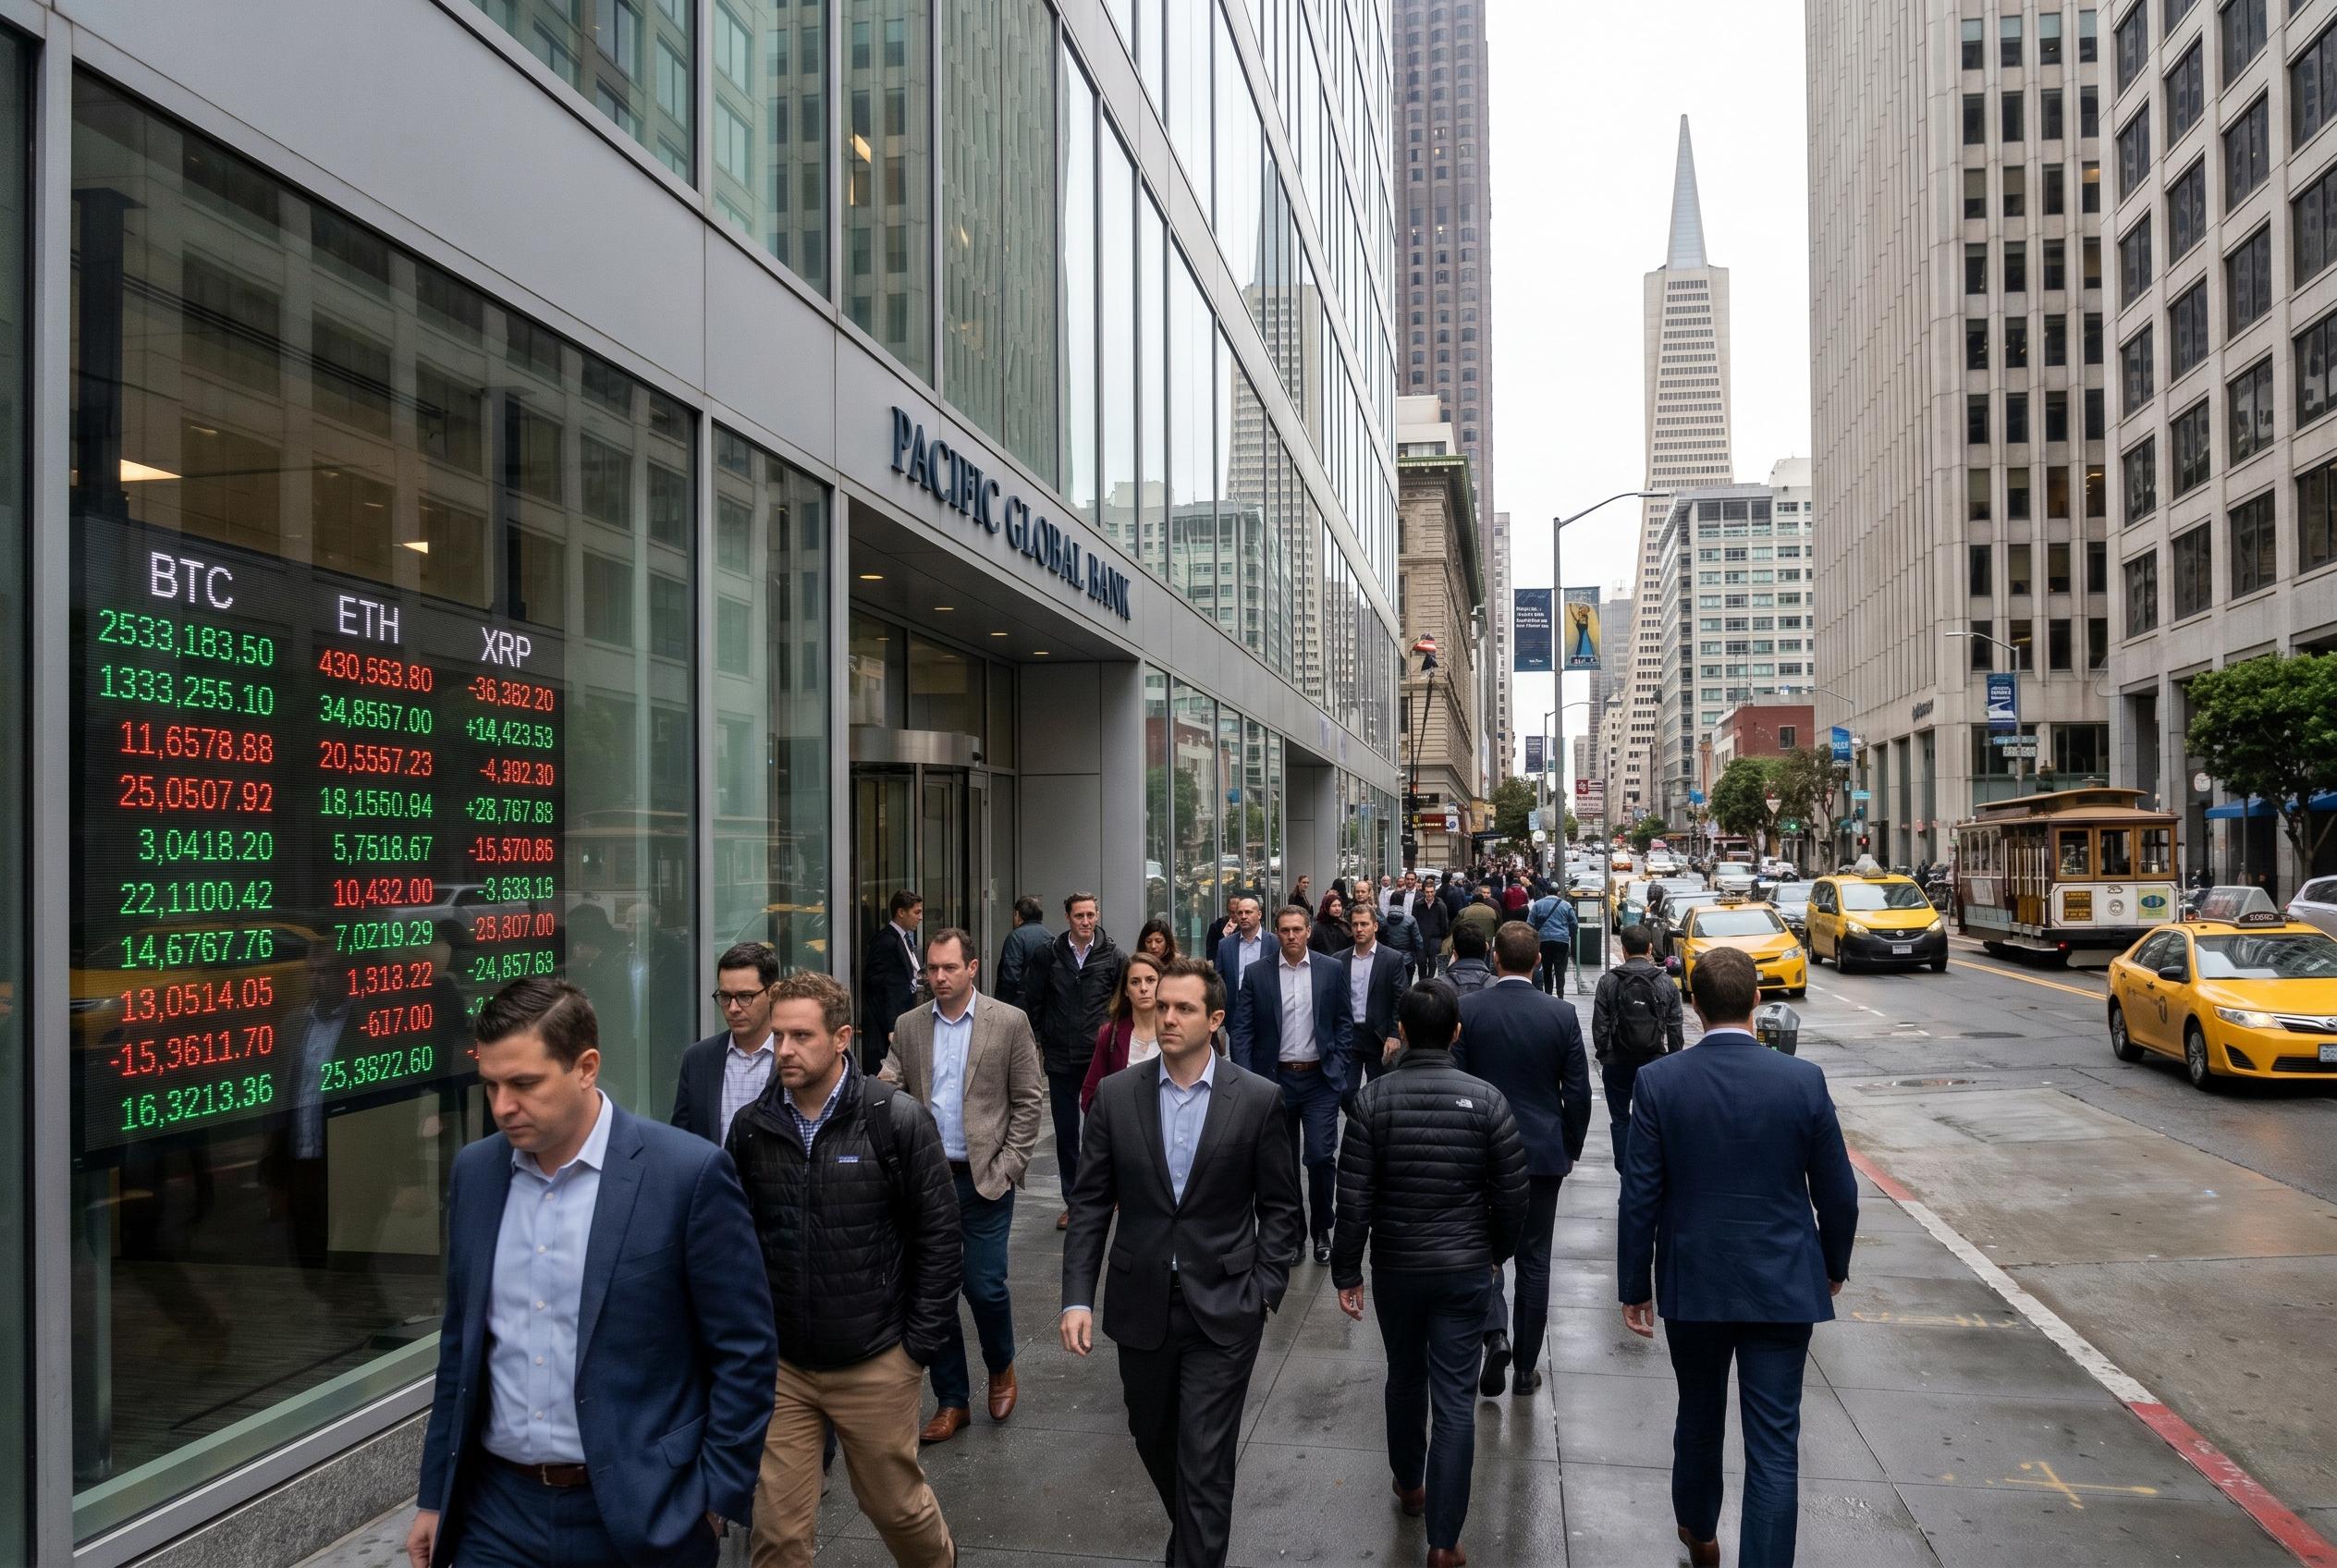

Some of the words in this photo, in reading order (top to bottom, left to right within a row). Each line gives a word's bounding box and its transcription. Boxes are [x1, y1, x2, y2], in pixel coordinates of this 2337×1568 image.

[891, 406, 999, 533] PACIFIC
[1005, 495, 1084, 590] GLOBAL
[1087, 552, 1132, 621] BANK
[152, 552, 233, 608] BTC
[340, 595, 398, 643] ETH
[482, 628, 531, 668] XRP
[101, 666, 273, 715] 1333,255.10
[122, 722, 273, 763] 11,6578.88
[466, 717, 552, 748] +14,423.53
[321, 741, 432, 775] 20,5557.23
[120, 775, 272, 811] 25,0507.92
[140, 829, 273, 865] 3,0418.20
[335, 834, 432, 863] 5,7518.67
[120, 881, 272, 917] 22,1100.42
[335, 879, 433, 907] 10,432.00
[122, 930, 273, 970] 14,6767.76
[121, 977, 273, 1022] 13,0514.05
[122, 1074, 273, 1130] 16,3213.36
